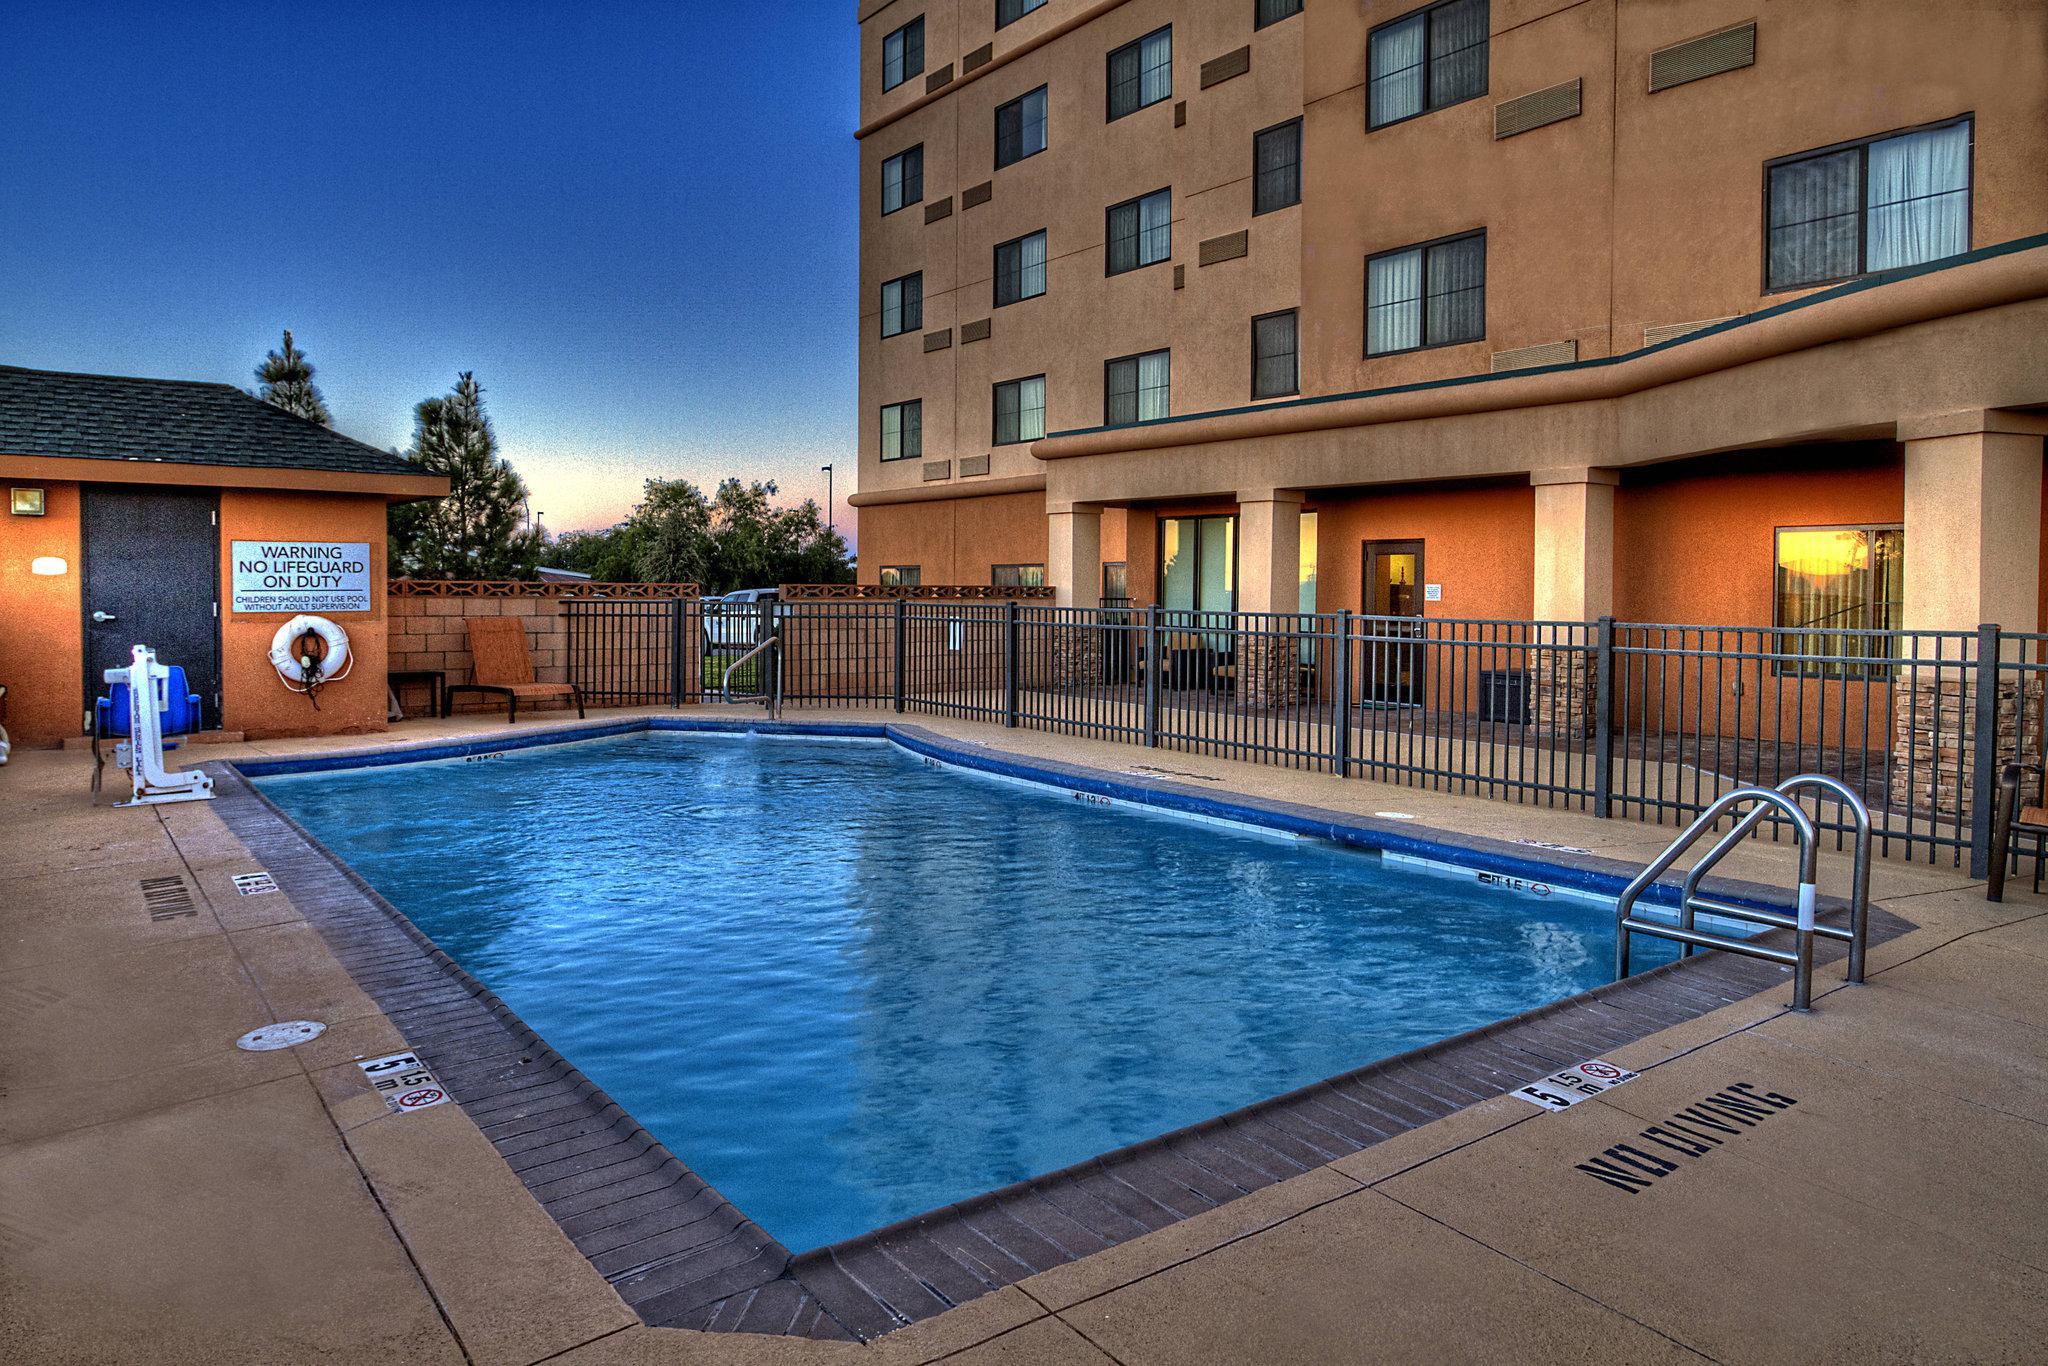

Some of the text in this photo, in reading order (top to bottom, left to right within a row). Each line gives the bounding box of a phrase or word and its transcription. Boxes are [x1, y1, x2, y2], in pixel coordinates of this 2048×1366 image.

[261, 546, 342, 559] WARNING
[239, 561, 364, 573] NO LIFEGUARD
[263, 575, 342, 588] ON DUTY
[235, 596, 276, 604] CHILDREN
[365, 1057, 416, 1072] 5
[400, 1070, 431, 1086] 1.5
[1548, 1072, 1582, 1087] 1.5
[374, 1079, 399, 1091] m
[1576, 1083, 1604, 1095] m
[1521, 1086, 1571, 1107] 5
[1574, 1082, 1798, 1194] NO DIVING
